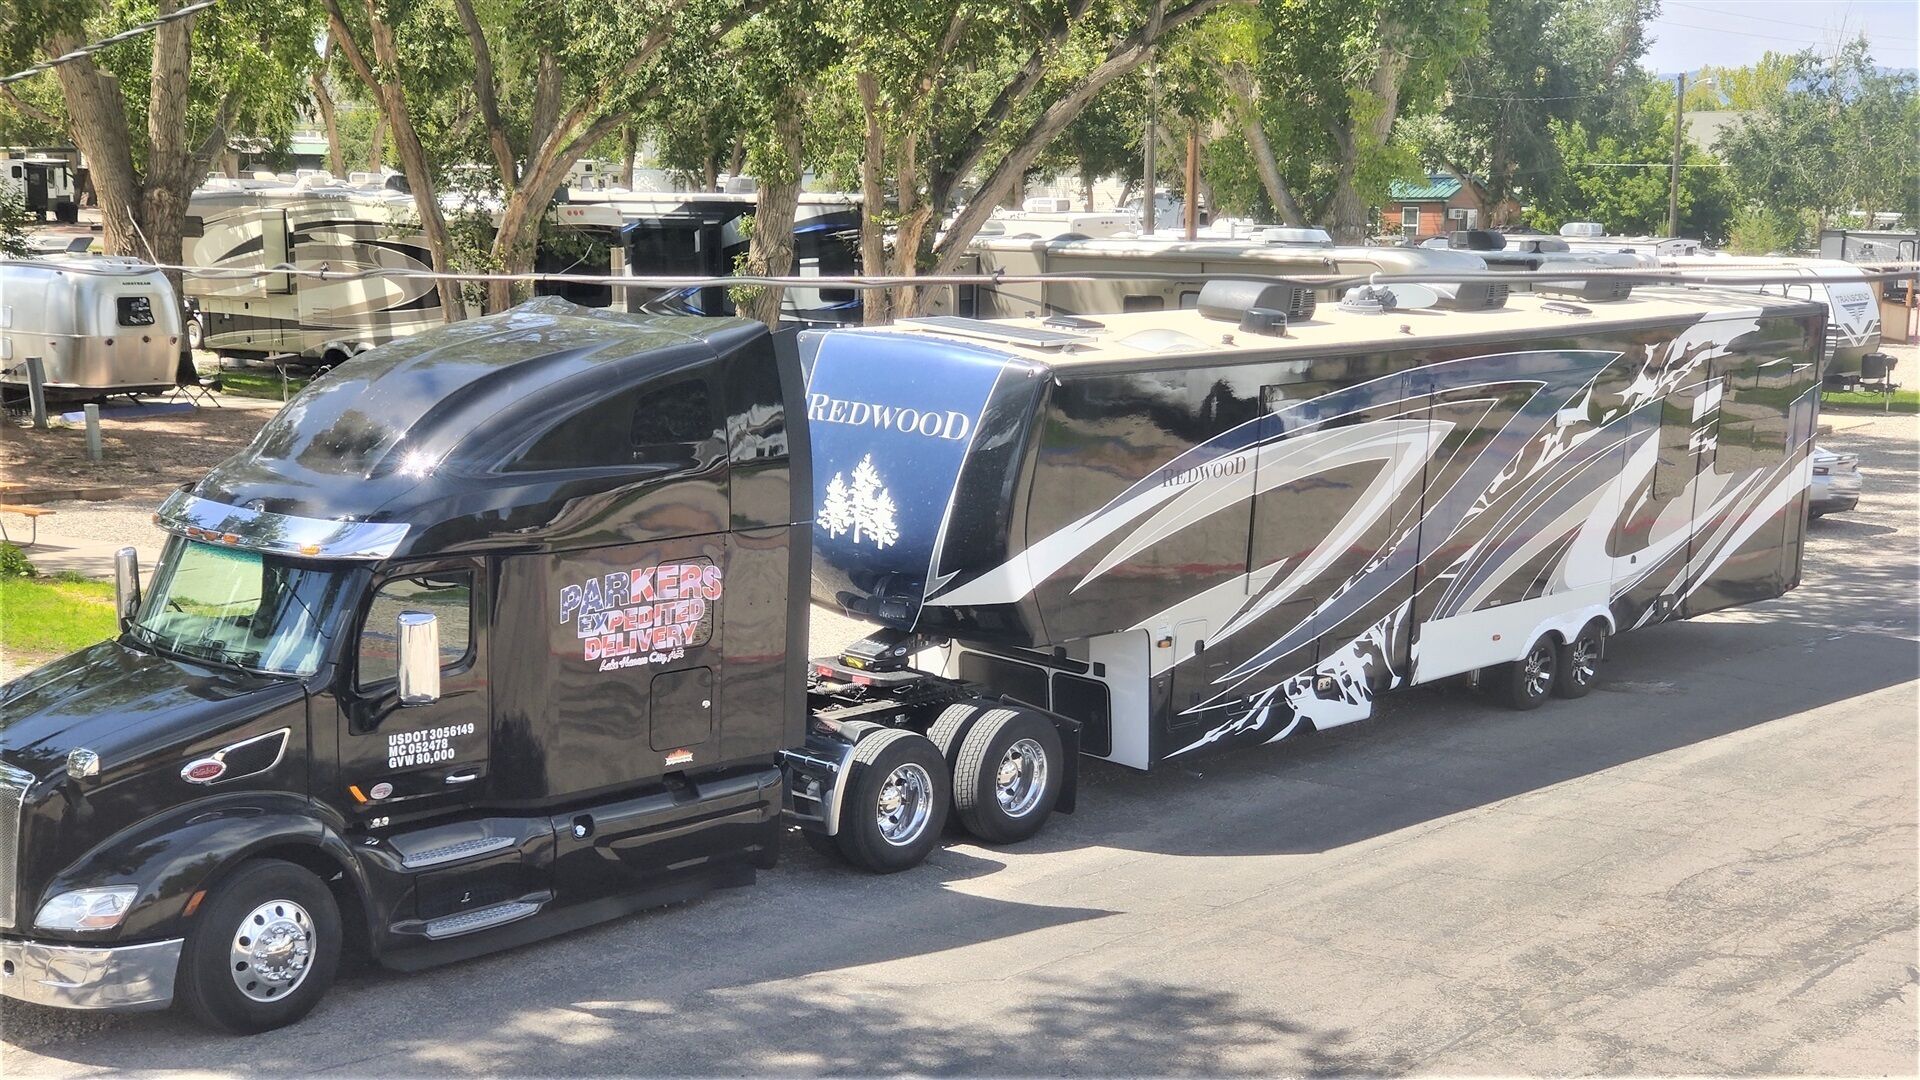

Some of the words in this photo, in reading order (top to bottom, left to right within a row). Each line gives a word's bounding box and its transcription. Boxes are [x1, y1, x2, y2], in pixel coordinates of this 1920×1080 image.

[807, 393, 969, 440] REDWOOD
[1161, 456, 1246, 487] REDWOOD
[560, 565, 722, 624] PARKERS
[577, 599, 705, 638] EXPEDITED
[585, 621, 698, 661] DELIVERY
[388, 730, 428, 746] USDOT
[429, 722, 474, 740] 3056149
[388, 745, 406, 758] MC
[408, 738, 448, 755] 052478
[388, 754, 414, 769] GVW
[416, 748, 455, 765] 80,000
